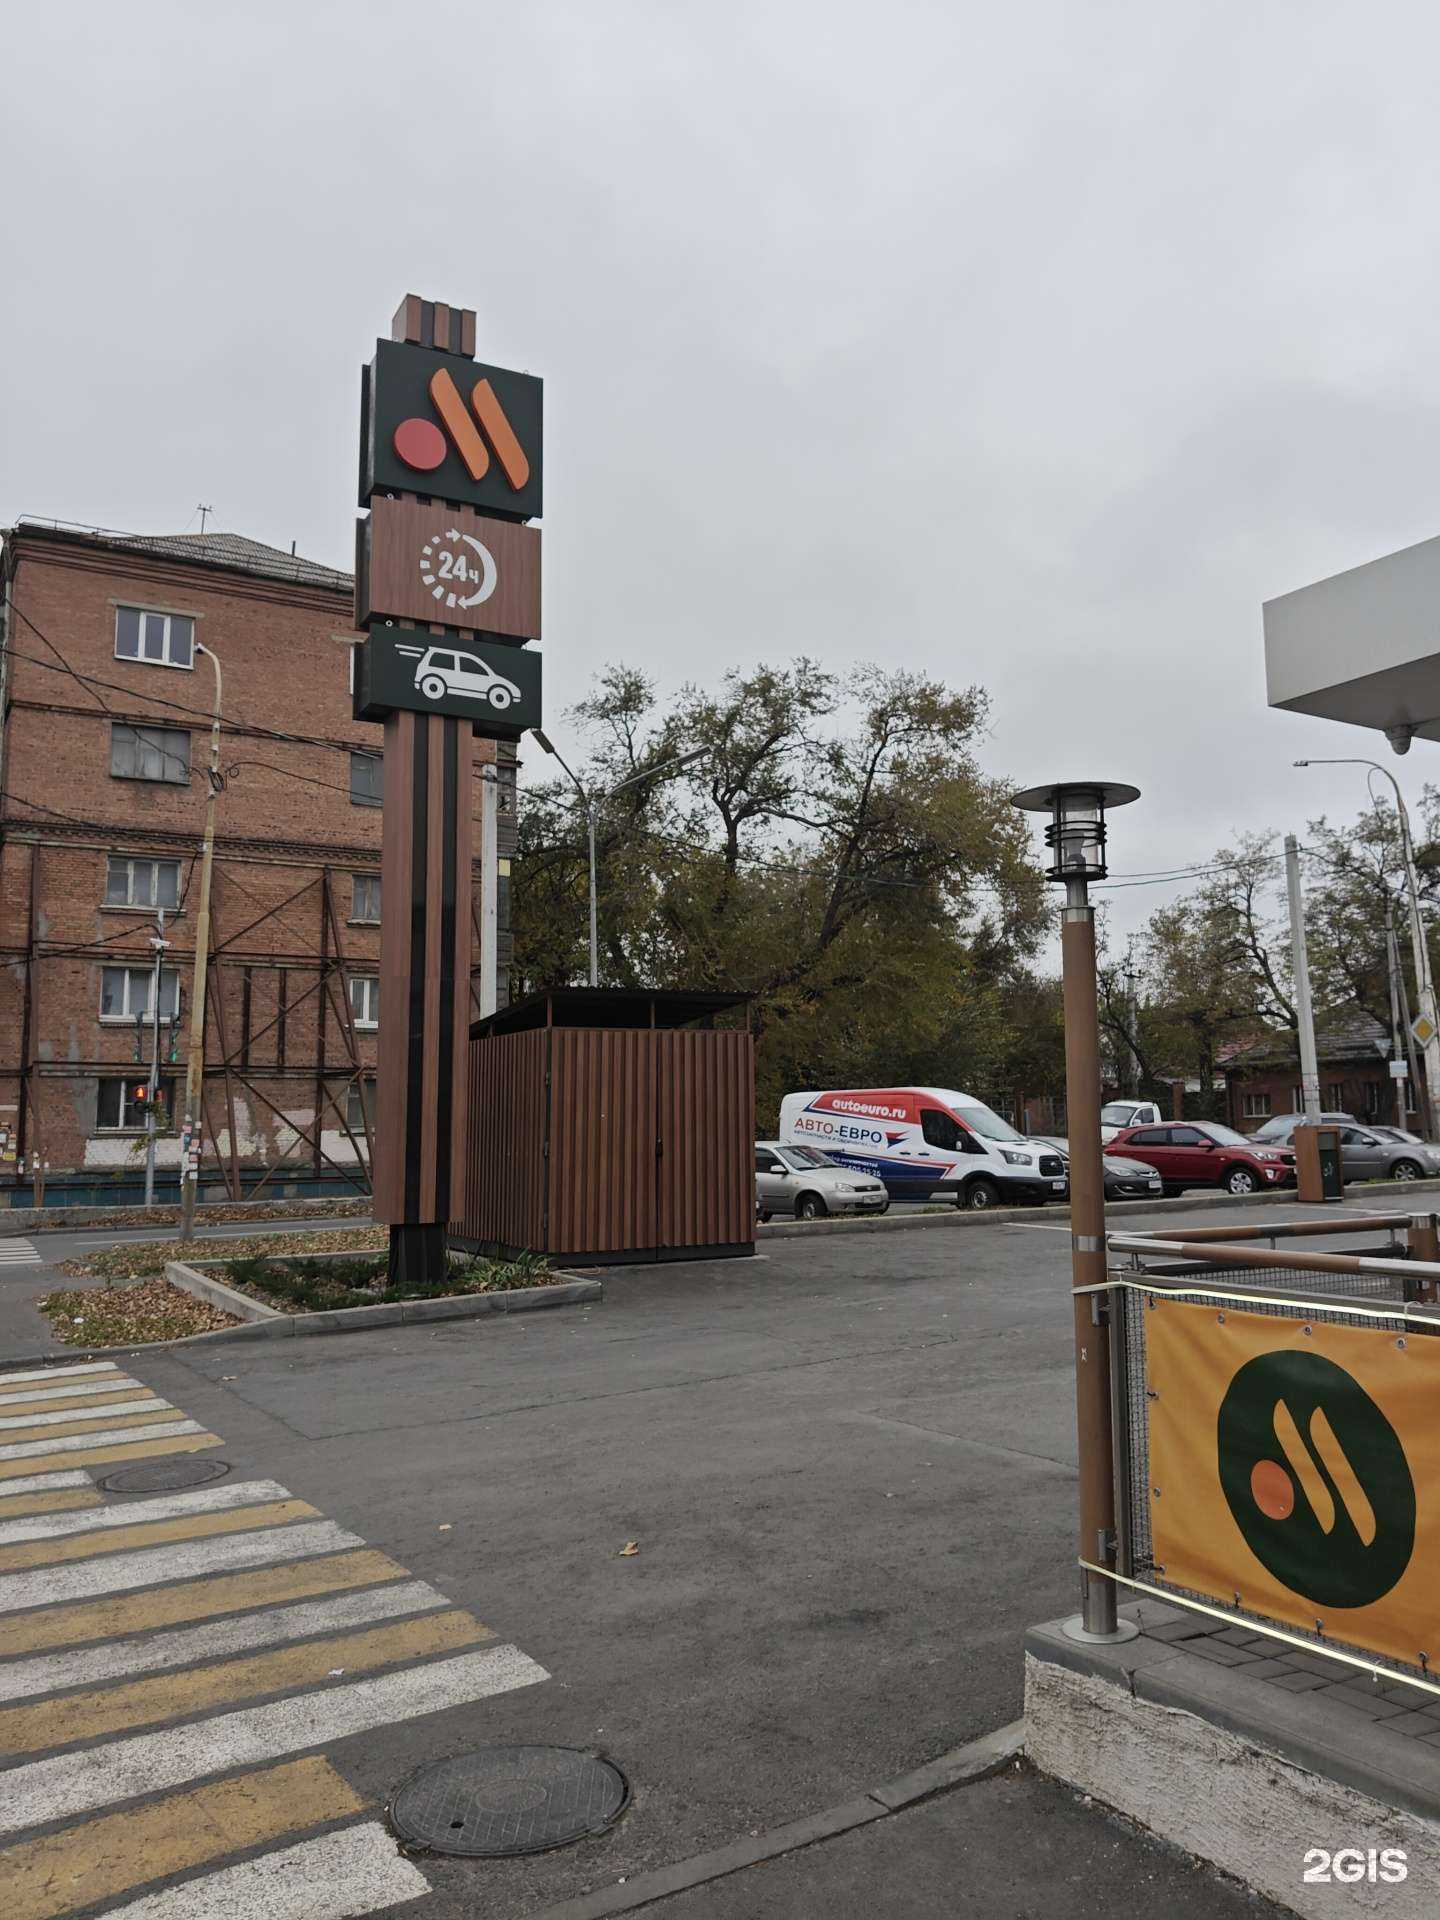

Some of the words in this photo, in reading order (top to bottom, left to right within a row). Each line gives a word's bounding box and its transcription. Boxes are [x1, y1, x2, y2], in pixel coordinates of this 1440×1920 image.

[438, 550, 479, 584] 24ч
[832, 1099, 906, 1118] autoeuro.ru
[794, 1118, 882, 1143] АВТО-ЕВРО
